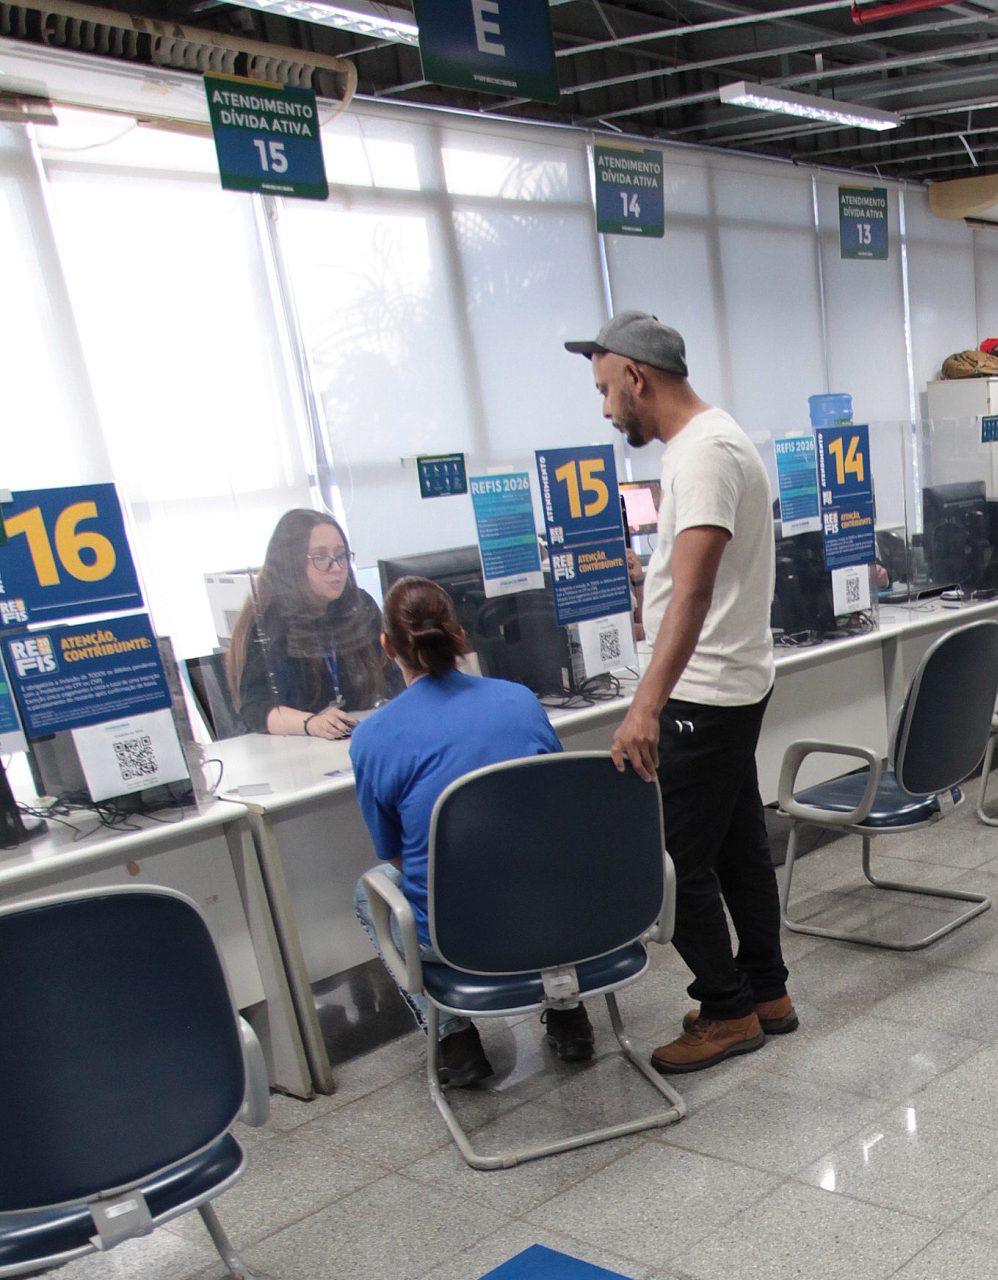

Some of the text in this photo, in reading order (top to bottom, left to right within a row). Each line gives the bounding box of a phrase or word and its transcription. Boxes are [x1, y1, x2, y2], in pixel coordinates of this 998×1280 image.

[471, 0, 506, 57] E
[212, 90, 313, 119] ATENDIMENTO
[220, 109, 312, 137] DÍVIDA ATIVA
[253, 139, 289, 174] 15
[598, 155, 661, 174] ATENDIMENTO
[602, 168, 658, 189] DÍVIDA ATIVA
[620, 191, 641, 218] 14
[840, 195, 886, 208] ATENDIMENTO
[843, 206, 884, 219] DÍVIDA ATIVA
[856, 223, 872, 245] 13
[828, 435, 864, 485] 14
[471, 478, 529, 495] REFIS 2026
[554, 458, 609, 519] 15
[4, 501, 117, 588] 16
[552, 554, 566, 569] RE
[554, 567, 575, 581] FIS
[11, 639, 40, 660] RE
[61, 629, 118, 650] ATENÇÃO,
[63, 637, 152, 662] CONTRIBUINTE:
[15, 655, 57, 677] FIS
